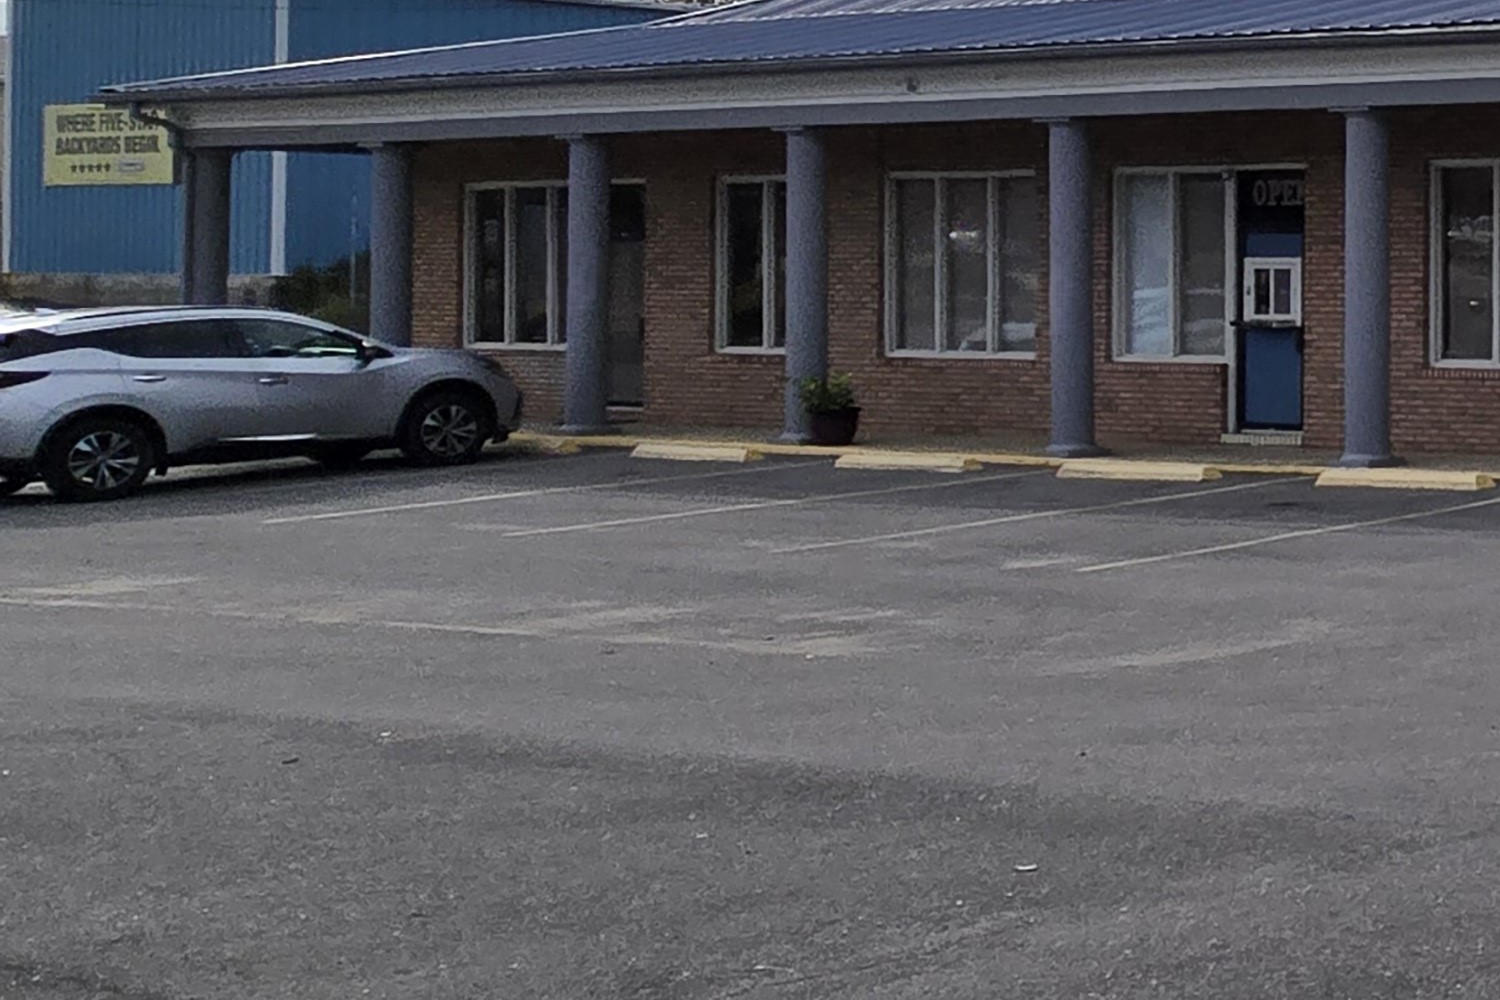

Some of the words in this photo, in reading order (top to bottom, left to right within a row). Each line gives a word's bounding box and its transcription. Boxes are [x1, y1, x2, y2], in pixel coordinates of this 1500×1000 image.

[56, 112, 96, 133] WHERE
[99, 110, 159, 132] FIVE-S
[55, 135, 121, 155] BACKYARDS
